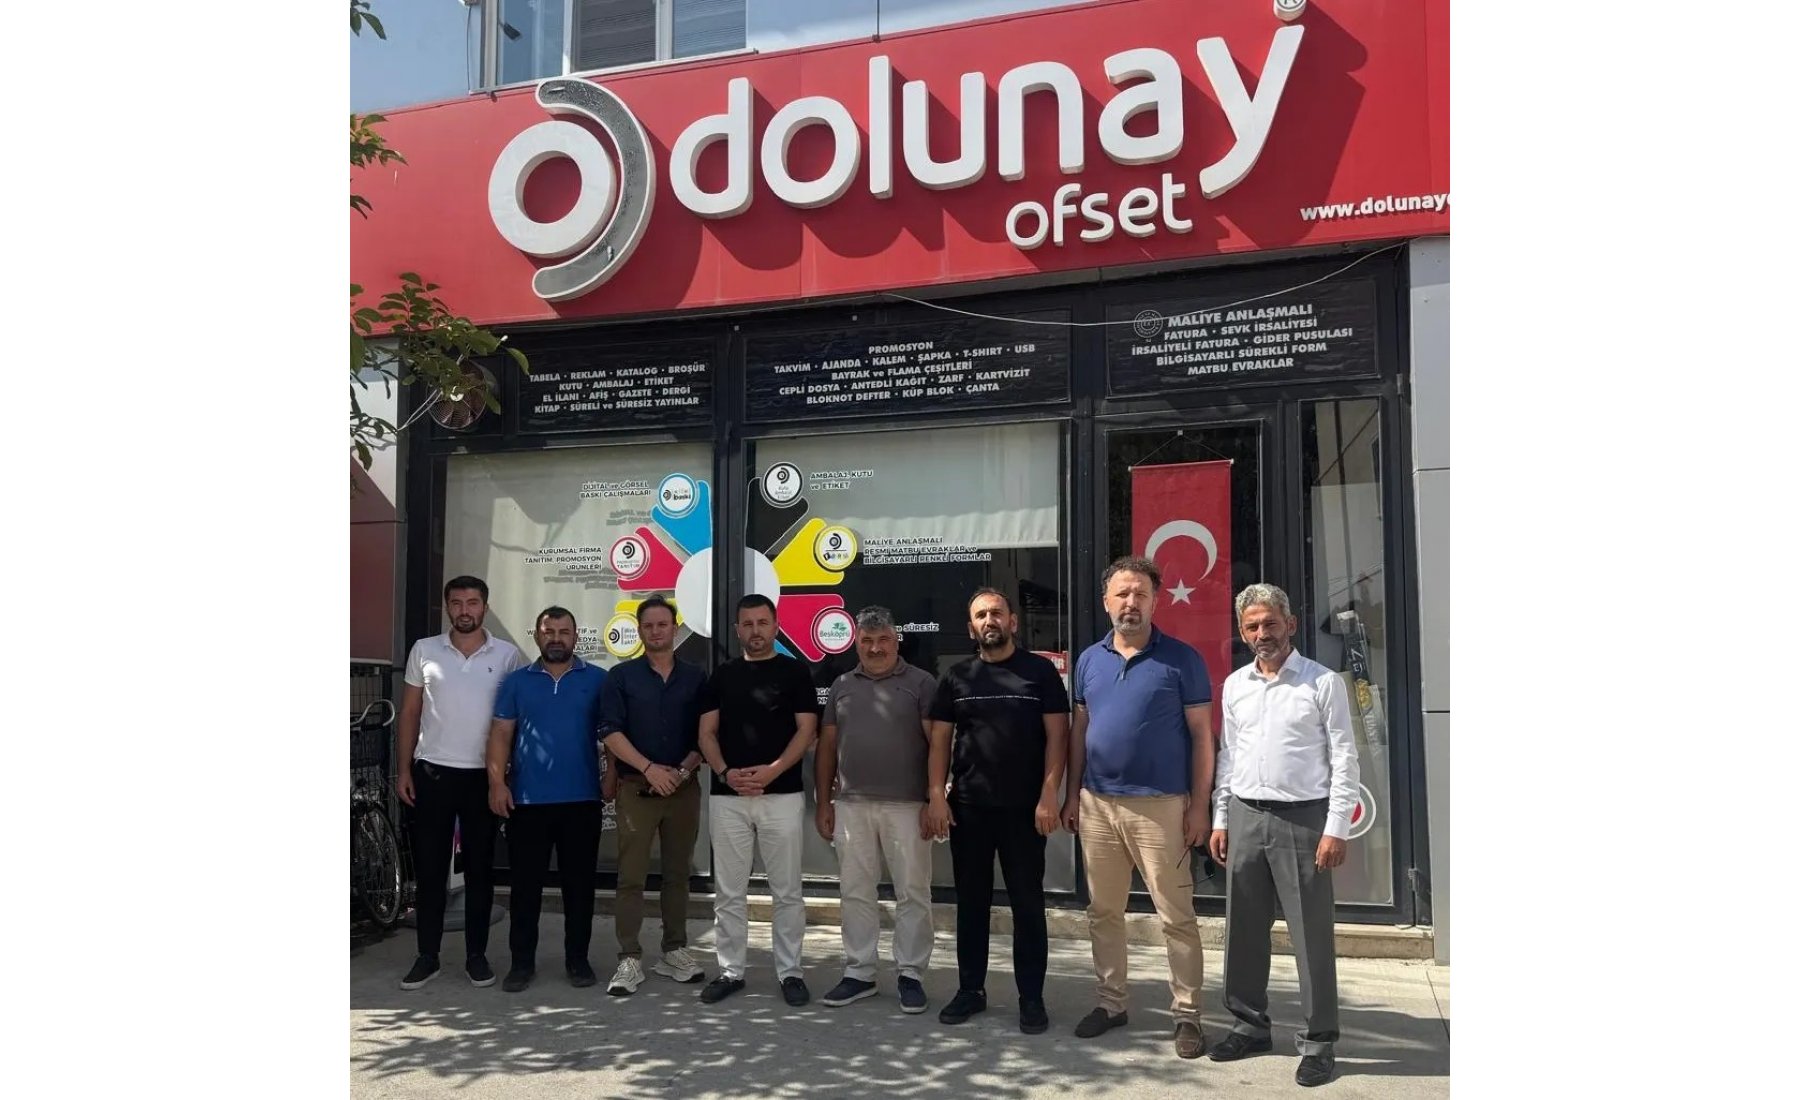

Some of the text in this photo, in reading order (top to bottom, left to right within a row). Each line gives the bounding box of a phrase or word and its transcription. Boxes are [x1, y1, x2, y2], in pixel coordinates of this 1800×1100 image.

[670, 25, 1304, 219] dolunay
[1005, 173, 1193, 251] ofset
[1225, 304, 1313, 321] ANLAŞMALI
[1164, 315, 1318, 341] FATURA SEVK İRSALİYESİ
[868, 341, 934, 355] PROMOSYON
[1131, 328, 1353, 356] İRSALİYELİ FATURA GİDER PUSULASI
[774, 343, 1036, 374] TAKVİM AJANDA KALEM ŞAPKA T-SHIRT USB
[1156, 342, 1328, 366] BİLGİSAYARLI SÜREKLİ FORM
[529, 361, 706, 383] TABELA REKLAM KATALOG BROŞÜR
[831, 360, 973, 381] BAYRAK ve FLAMA ÇEŞİTLERİ
[1187, 358, 1294, 376] MATBU EVRAKLAR
[559, 376, 674, 391] KUTU AMBALAJ ETİKET
[779, 367, 1031, 396] CEPLİ DOSYA ANTEDLİ KAĞIT ZARF KARTVİZİT
[542, 384, 691, 403] EL İLANI AFİŞ GAZETE DERGİ
[806, 382, 1000, 405] BLOKNOT DEFTER KÜP BLOK ÇANTA
[534, 396, 700, 414] KİTAP SÜRELİ ve SÜRESİZ YAYINLAR
[851, 470, 874, 478] KUTU
[603, 489, 651, 498] ÇALIŞMALARI
[891, 546, 920, 554] MATBU
[922, 545, 965, 553] EVRAKLAR
[951, 552, 991, 562] FORMLAR
